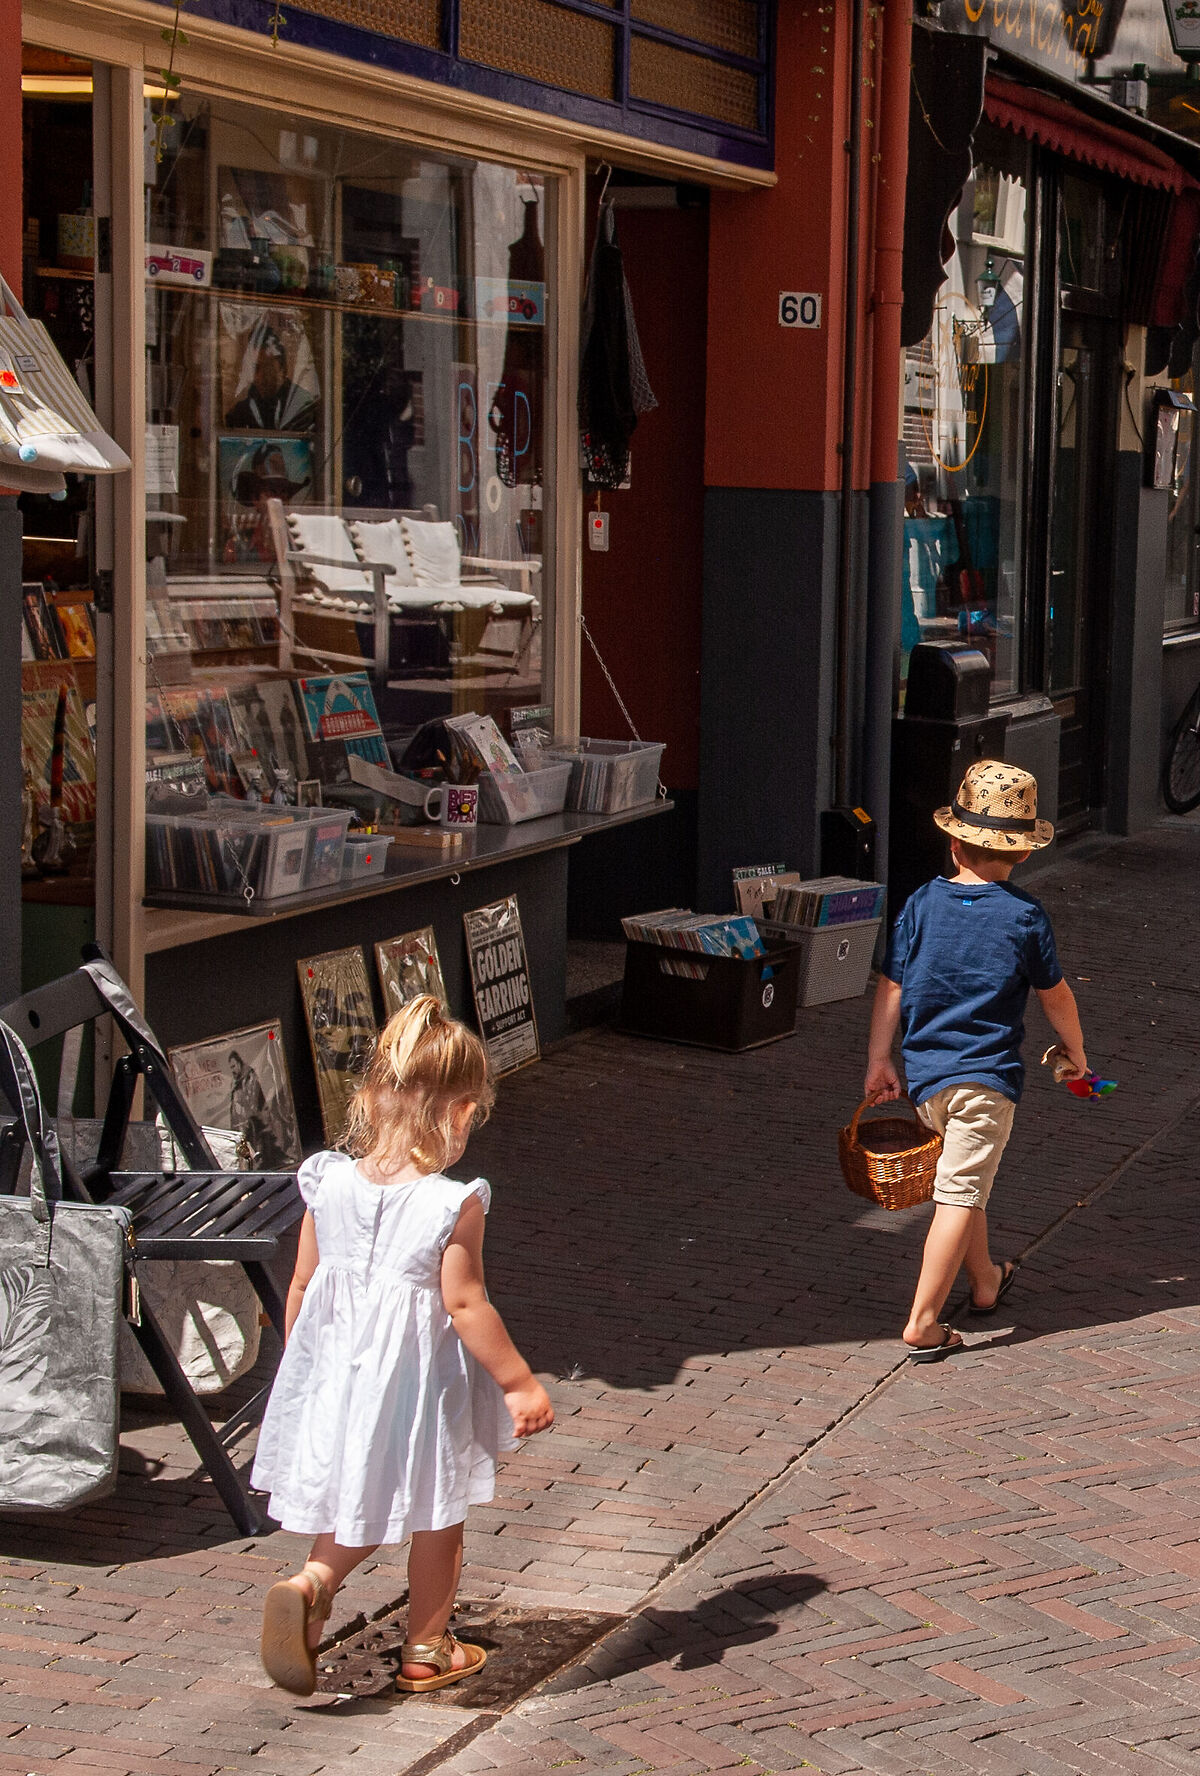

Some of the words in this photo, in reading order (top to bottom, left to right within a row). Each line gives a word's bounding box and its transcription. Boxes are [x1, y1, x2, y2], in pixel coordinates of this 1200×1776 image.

[781, 296, 817, 324] 60
[476, 937, 522, 984] GOLDEN
[476, 972, 529, 1022] EARRING
[496, 1013, 517, 1031] SUPPORT
[516, 1009, 526, 1021] ACT
